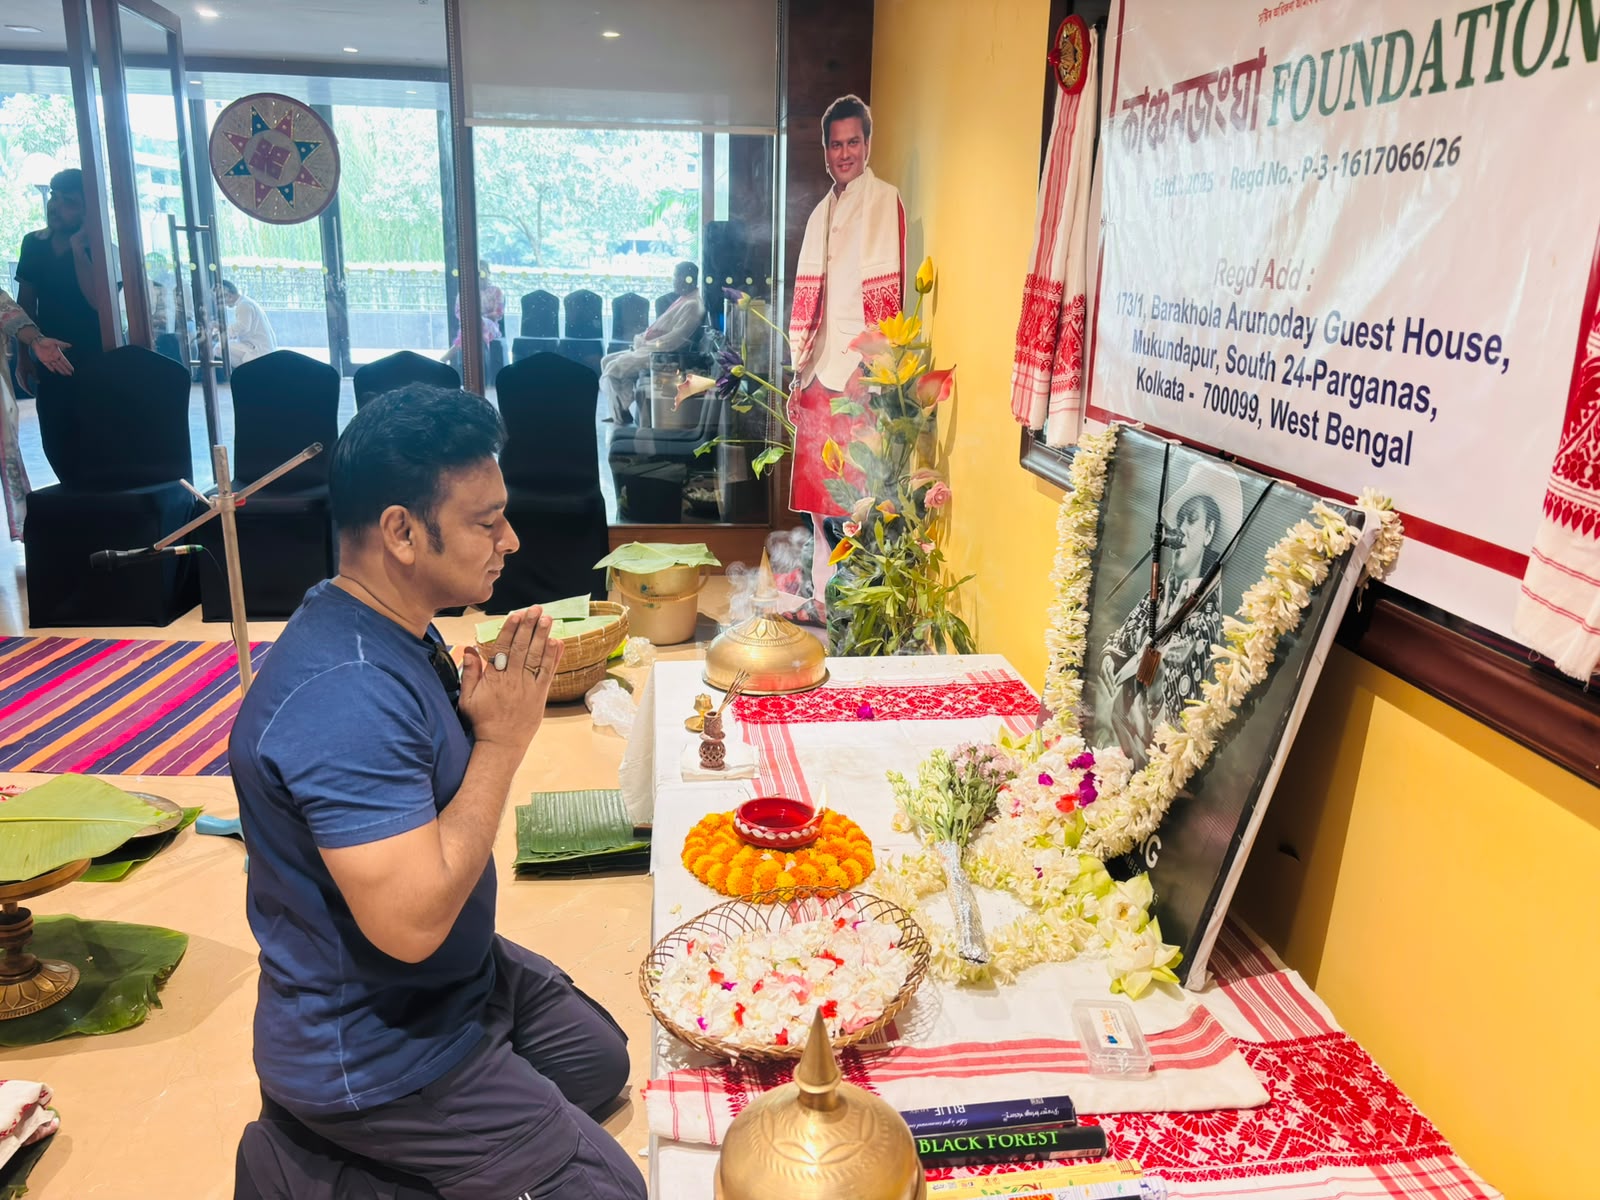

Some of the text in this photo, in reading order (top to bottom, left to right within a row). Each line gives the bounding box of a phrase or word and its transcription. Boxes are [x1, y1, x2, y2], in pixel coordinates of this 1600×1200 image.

[1267, 0, 1600, 126] FOUNDATION
[1230, 161, 1266, 194] Regd
[1215, 258, 1259, 295] Regd
[1260, 258, 1304, 291] Add
[1116, 290, 1510, 374] 173/1, Barakhola Arunoday Guest House,
[1132, 329, 1438, 422] Mukundapur, South 24-Parganas,
[1137, 366, 1185, 402] Kolkata
[1203, 382, 1262, 431] 700099,
[1270, 398, 1320, 441] West
[1325, 411, 1413, 468] Bengal
[918, 1131, 1059, 1154] BLACK FOREST
